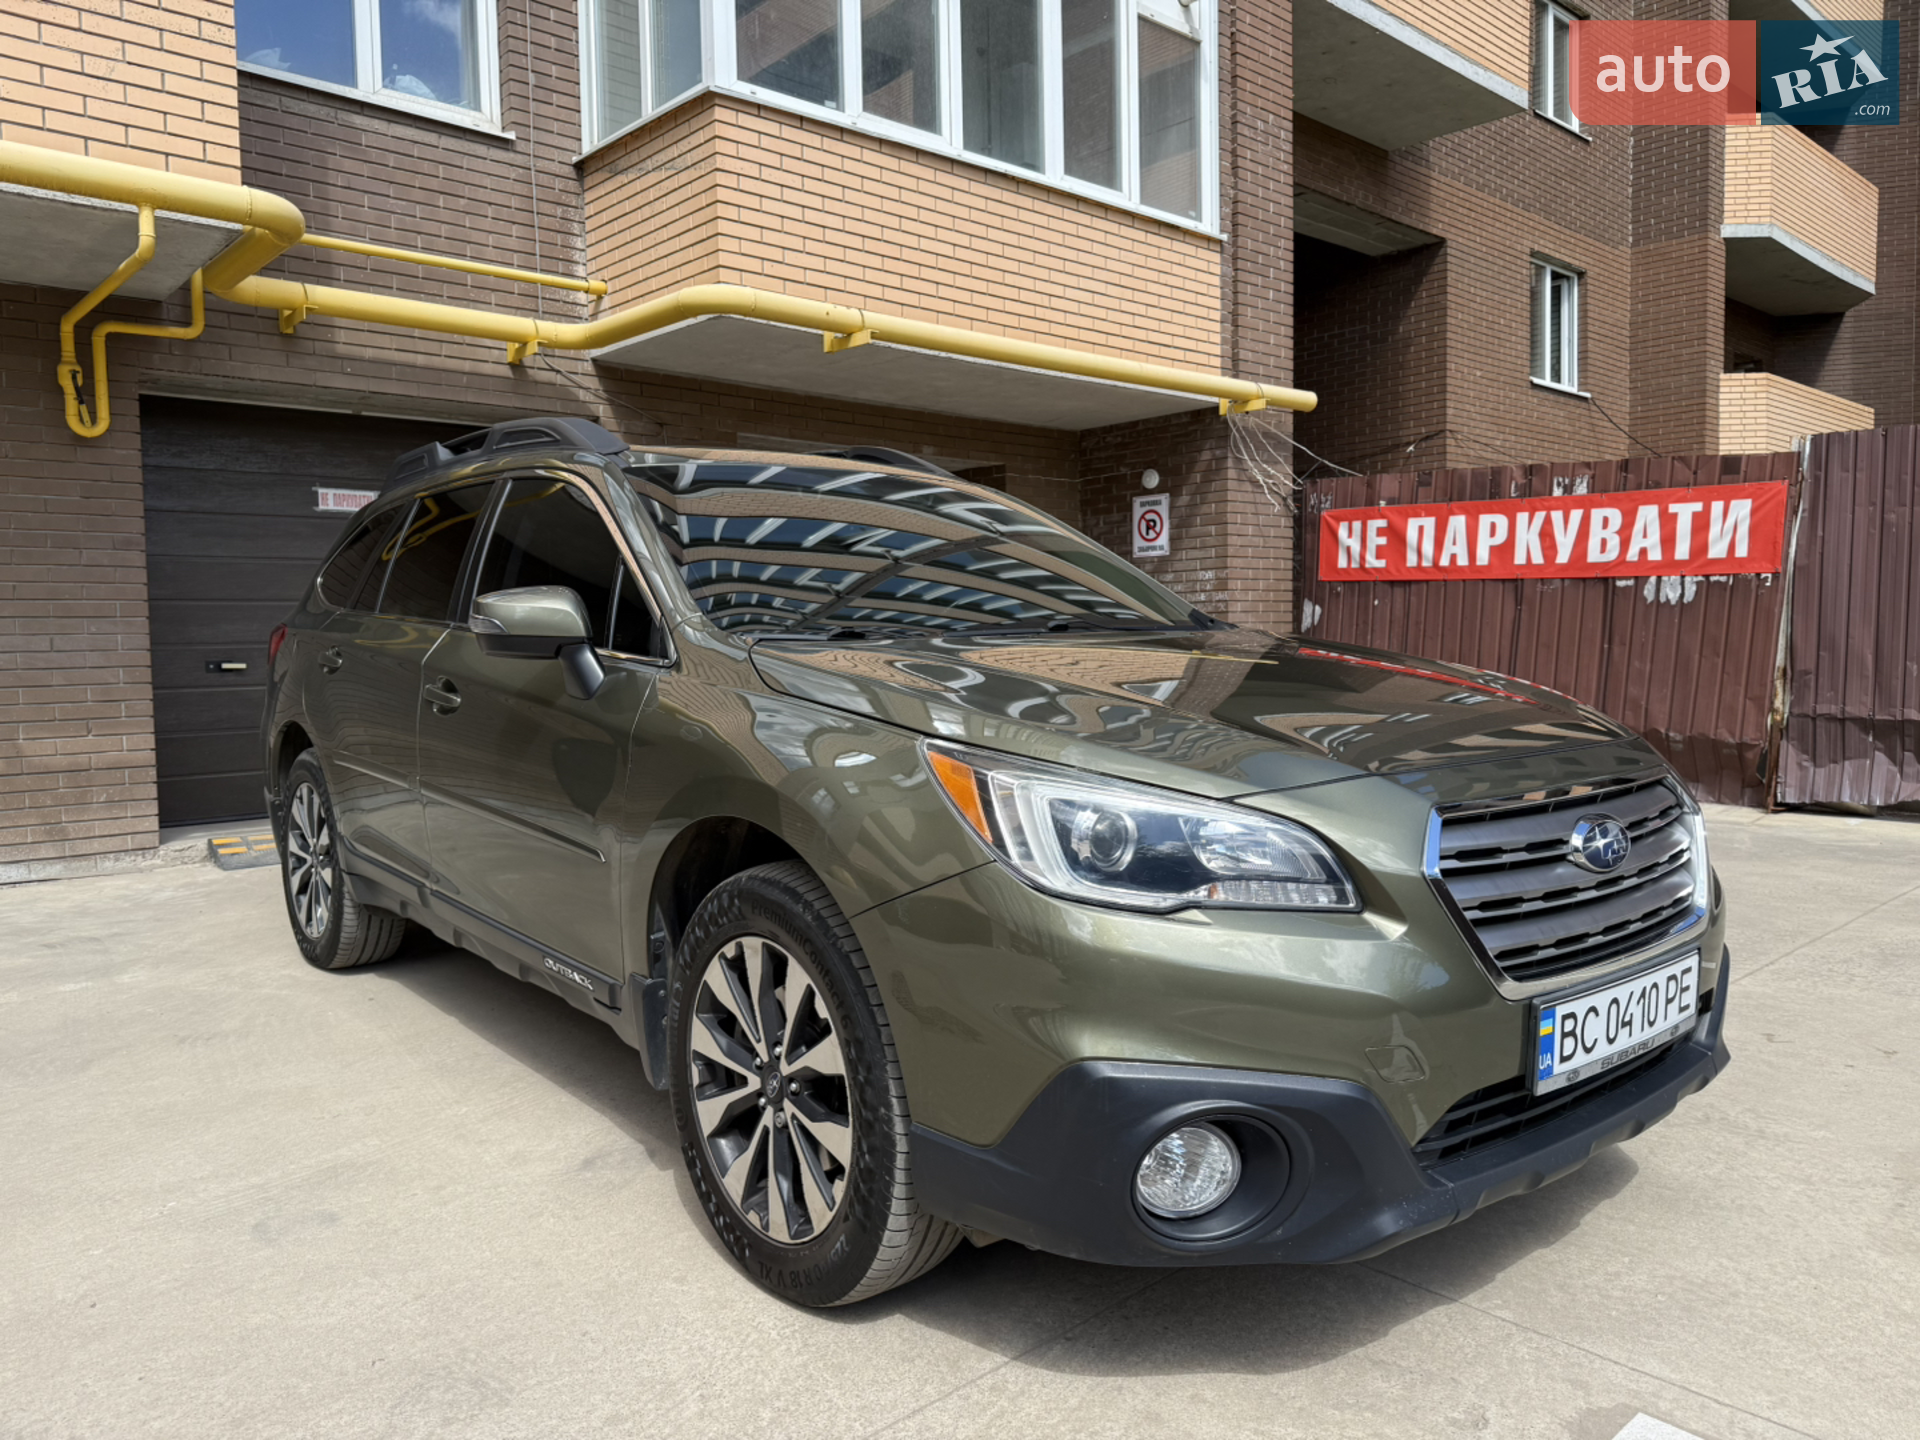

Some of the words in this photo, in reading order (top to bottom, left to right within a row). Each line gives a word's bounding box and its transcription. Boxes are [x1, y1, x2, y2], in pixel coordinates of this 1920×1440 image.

[1337, 519, 1388, 569] НЕ
[1406, 498, 1752, 567] ПАРКУВАТИ
[543, 957, 594, 991] OUTBACK
[1559, 1005, 1600, 1065] BC
[1606, 981, 1660, 1045] 0410
[1663, 965, 1693, 1023] PE
[1539, 1052, 1553, 1069] UA
[1600, 1038, 1656, 1070] SUBARU
